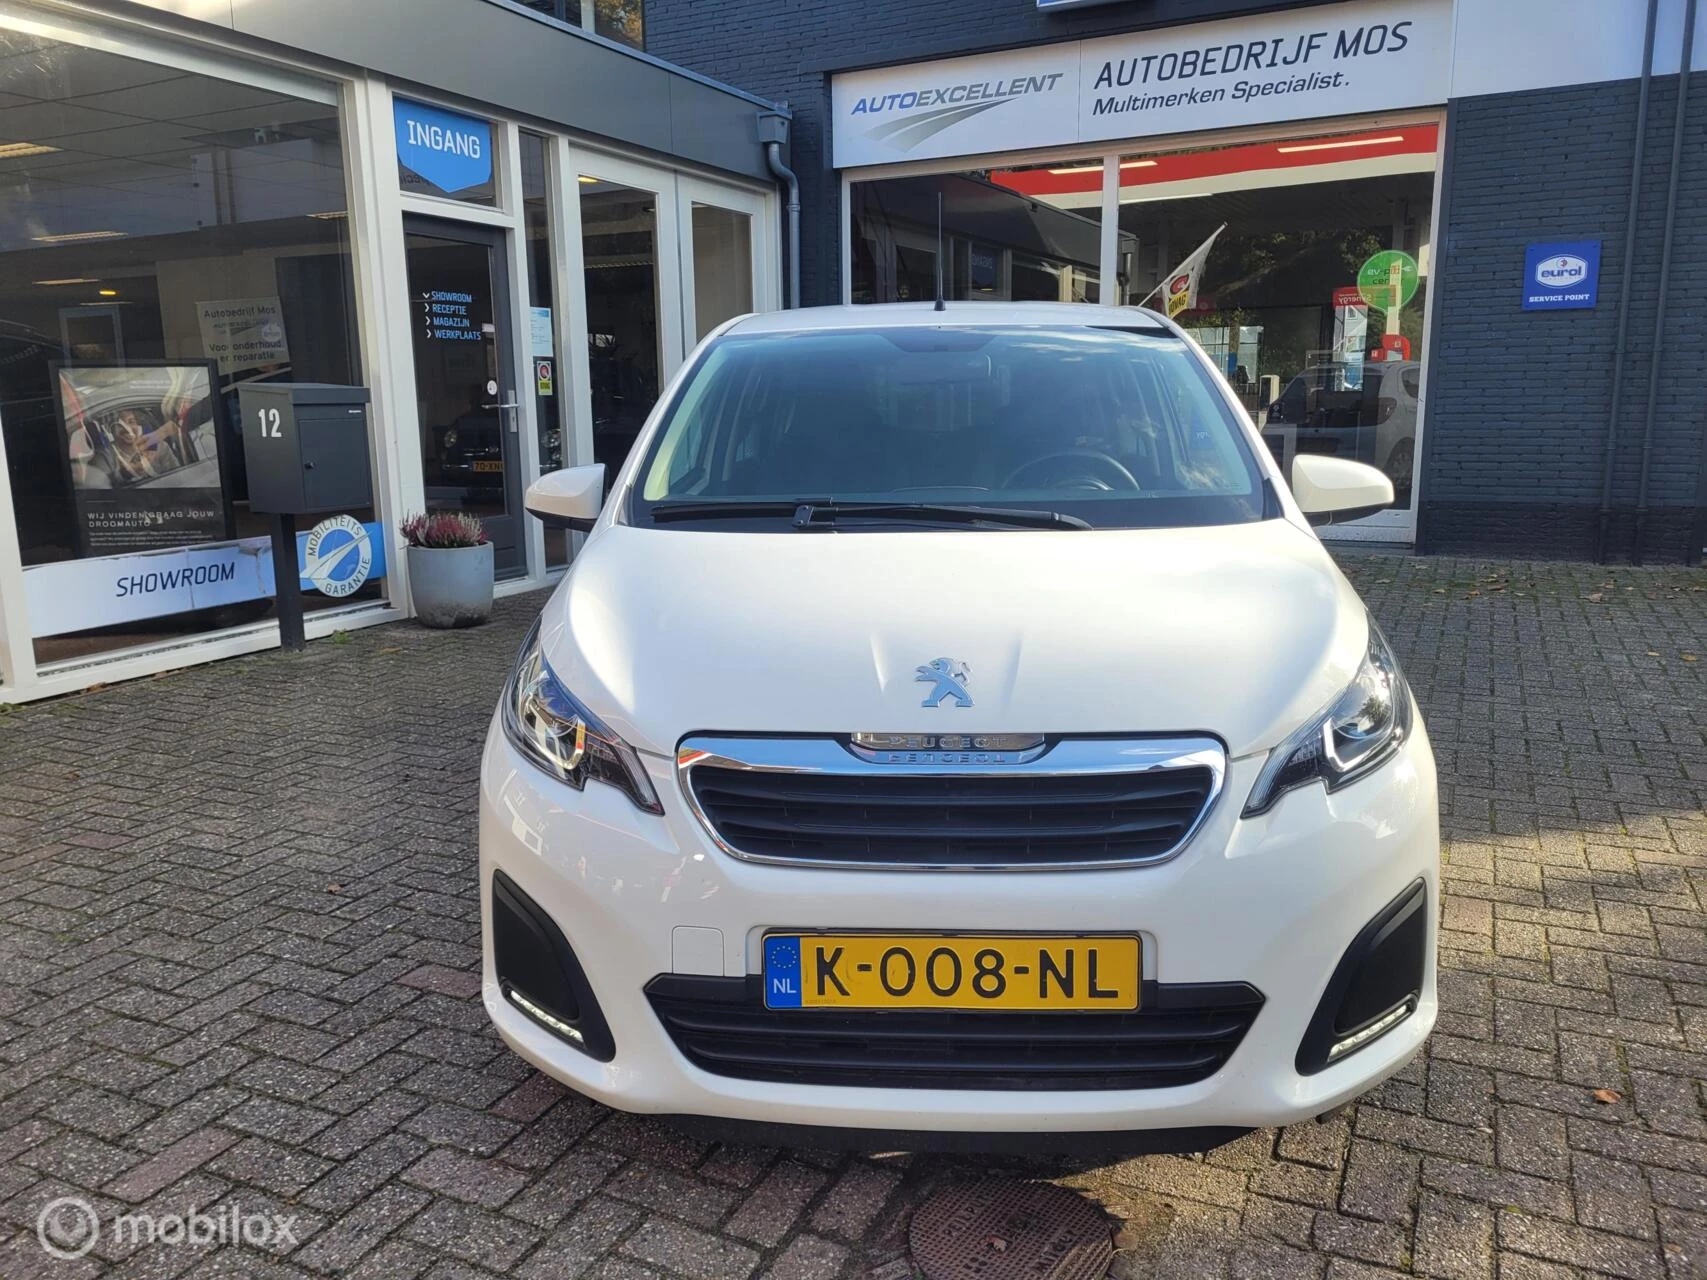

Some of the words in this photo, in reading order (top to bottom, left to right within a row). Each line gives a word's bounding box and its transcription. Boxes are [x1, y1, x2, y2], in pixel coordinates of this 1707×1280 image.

[1093, 32, 1328, 90] AUTOBEDRIJF
[1333, 21, 1413, 60] MOS
[850, 73, 1064, 116] AUTOEXCELLENT
[1092, 87, 1226, 115] Multimerken
[1230, 71, 1350, 101] Specialist.
[406, 119, 481, 159] INGANG
[1541, 266, 1582, 278] eurol
[431, 291, 472, 303] SHOWROOM
[1528, 295, 1563, 303] SERVICE
[1564, 293, 1590, 301] POINT
[203, 306, 256, 319] Autobedrijf
[256, 305, 277, 315] Mos
[432, 303, 467, 315] RECEPTIE
[433, 317, 470, 328] MAGAZIJN
[434, 329, 482, 340] WERKPLAATS
[258, 408, 282, 438] 12
[87, 512, 105, 520] WIJ
[186, 510, 215, 519] JOUW
[307, 516, 362, 557] MOBILITEITS
[115, 562, 236, 598] SHOWROOM
[325, 556, 370, 595] GARANTIE
[815, 945, 1120, 999] K-008-NL
[772, 978, 797, 994] NL
